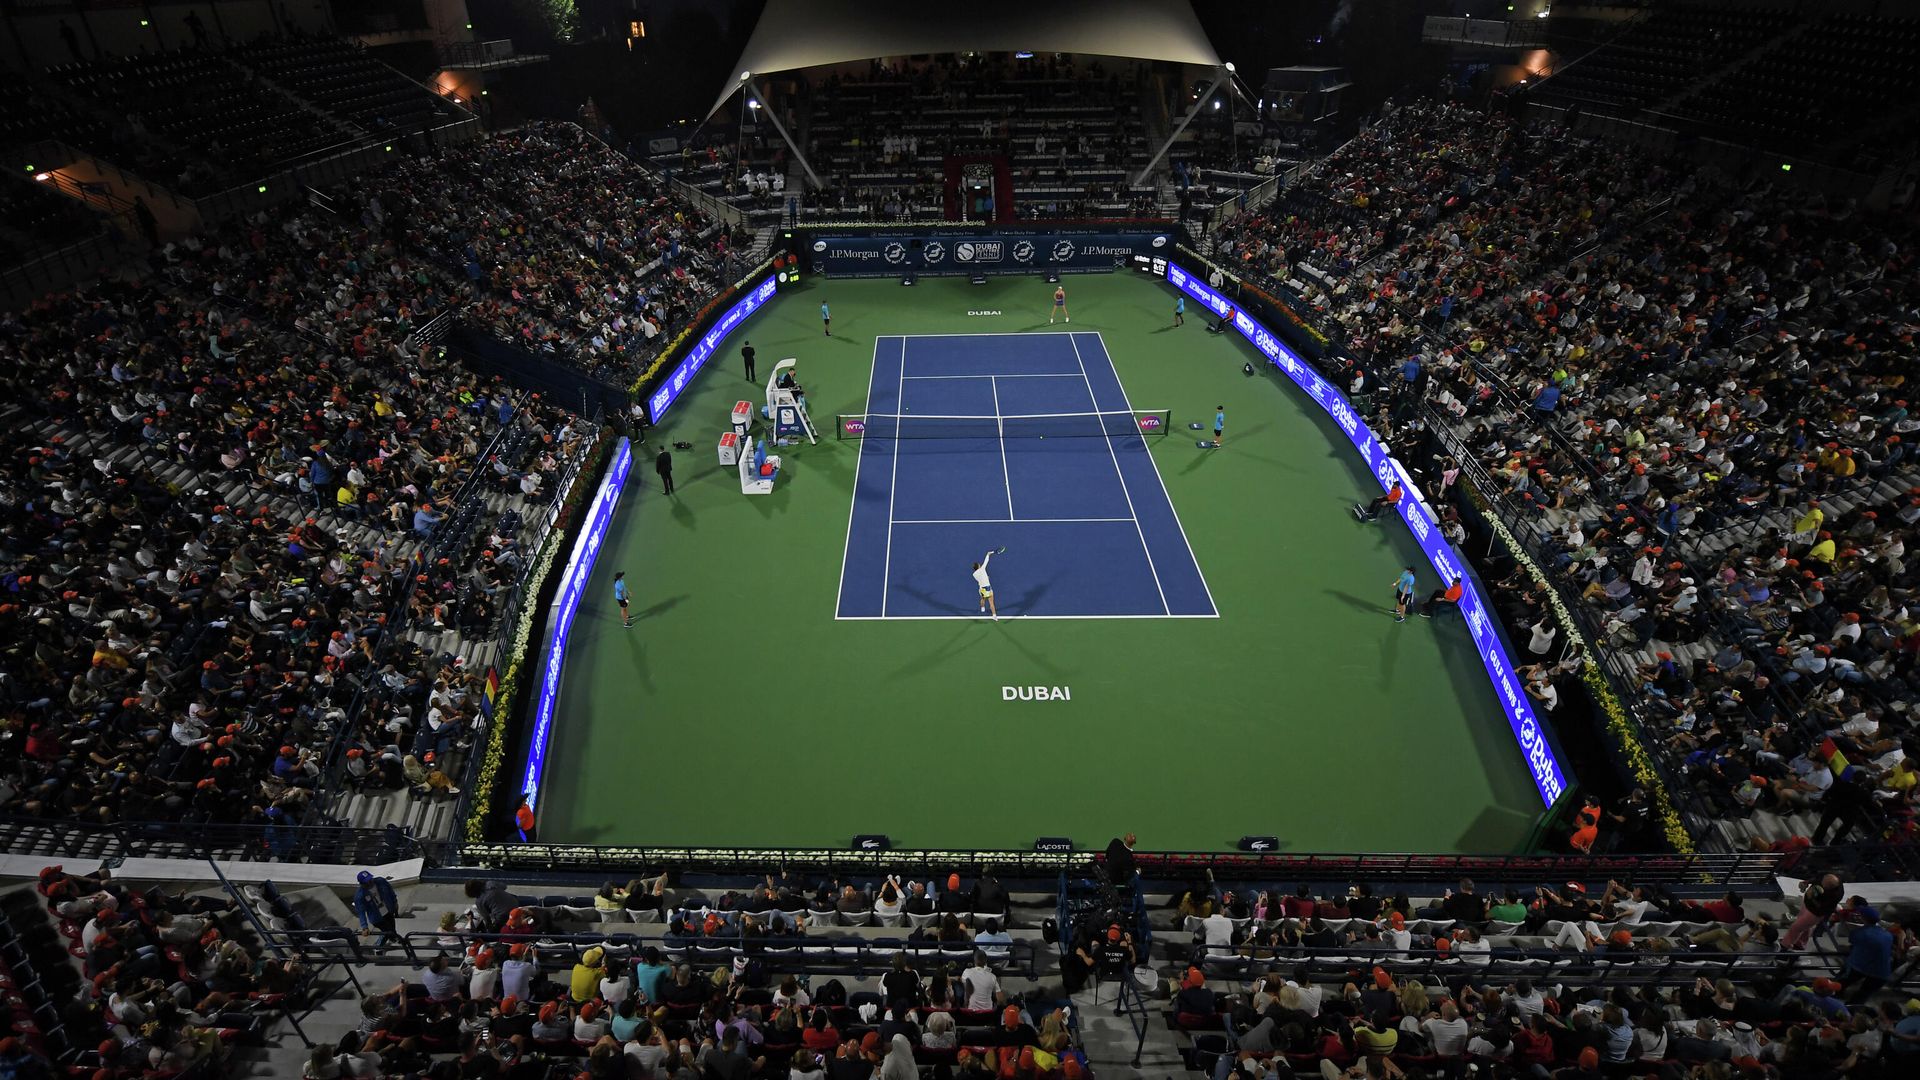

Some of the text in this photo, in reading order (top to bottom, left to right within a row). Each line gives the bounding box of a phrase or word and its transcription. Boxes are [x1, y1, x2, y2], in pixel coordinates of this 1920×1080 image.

[830, 250, 879, 260] J.P.Morgan
[1081, 246, 1132, 256] J.P.Morgan
[1263, 333, 1279, 353] Dubai
[1341, 404, 1357, 430] Dubai
[1490, 650, 1517, 707] GULF NEWS
[1002, 686, 1070, 700] DUBAI
[1530, 748, 1543, 780] Duty
[1534, 735, 1561, 799] Dubai
